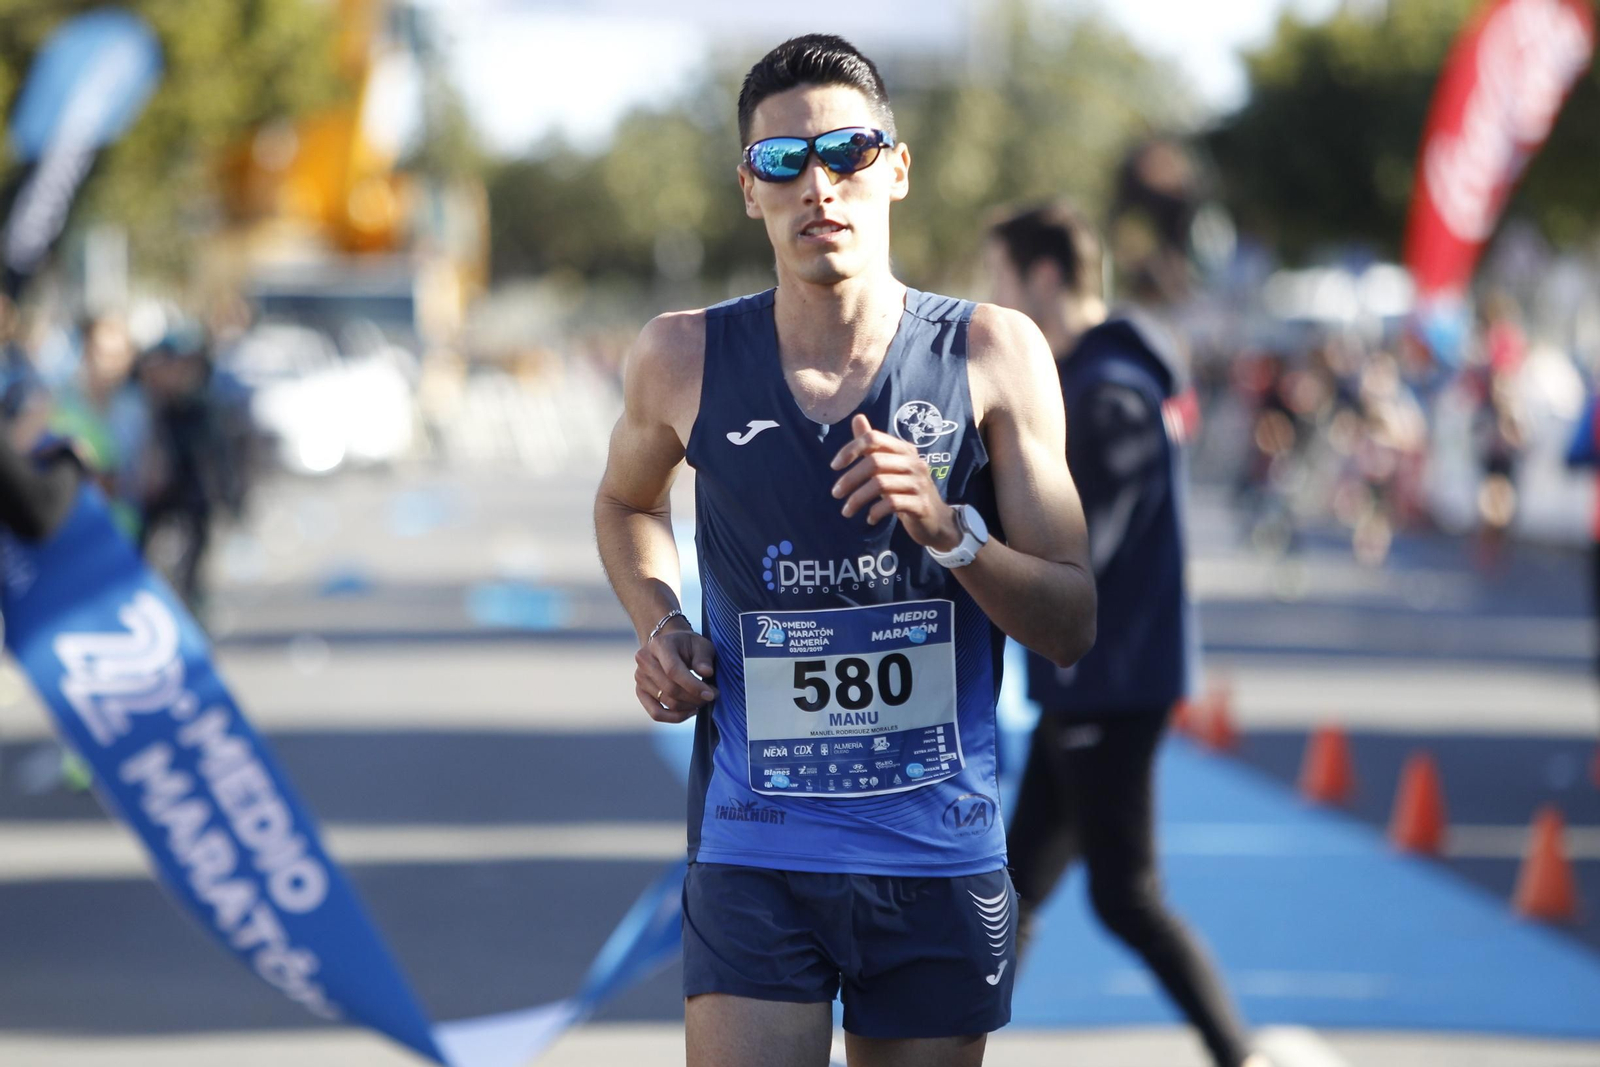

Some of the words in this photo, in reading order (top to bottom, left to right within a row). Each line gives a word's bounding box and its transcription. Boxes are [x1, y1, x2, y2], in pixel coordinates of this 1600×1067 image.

[779, 549, 899, 586] DEHARO
[780, 574, 902, 594] PODOLOGOS
[893, 609, 938, 624] MEDIO
[787, 621, 817, 630] MEDIO
[788, 627, 834, 638] MARATÓN
[789, 636, 830, 647] ALMERÍA
[792, 652, 913, 713] 580
[829, 711, 880, 727] MANU
[836, 728, 871, 736] RODRIGUEZ
[871, 725, 899, 734] MORALES
[794, 744, 815, 755] CDX
[834, 742, 863, 751] ALMERÍA
[763, 747, 788, 759] NEXA
[178, 708, 329, 914] MEDIO
